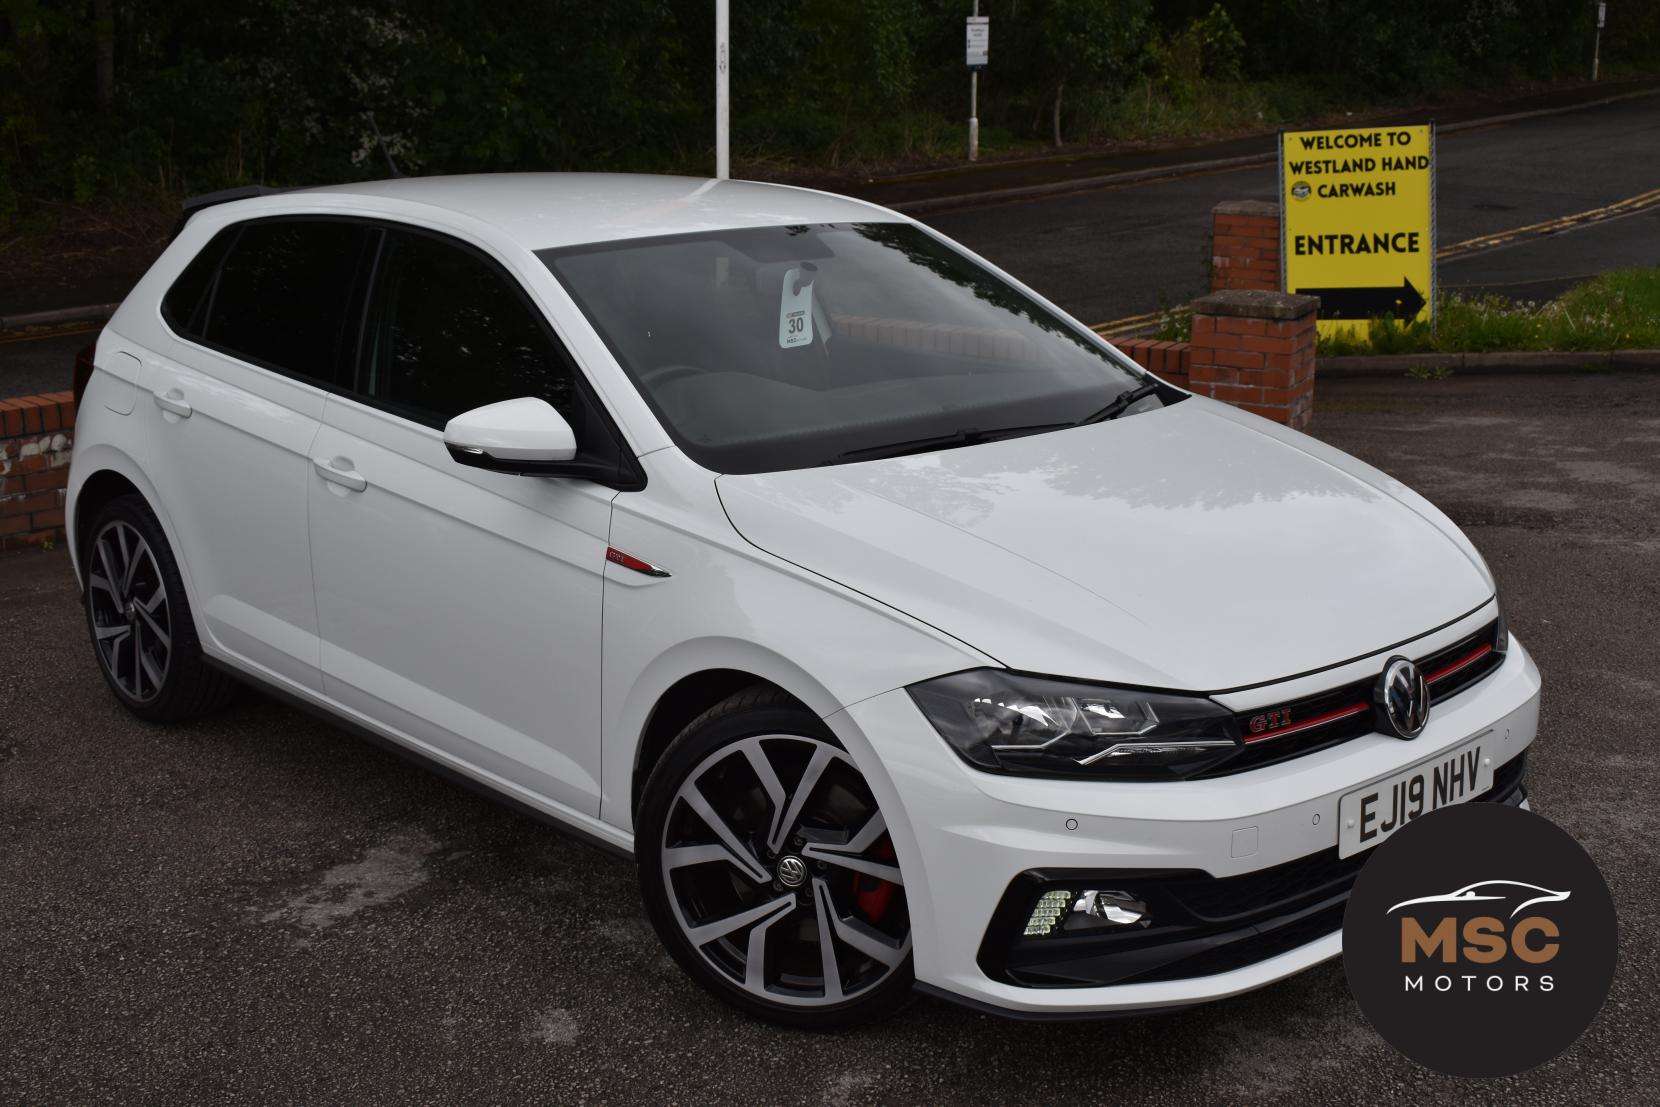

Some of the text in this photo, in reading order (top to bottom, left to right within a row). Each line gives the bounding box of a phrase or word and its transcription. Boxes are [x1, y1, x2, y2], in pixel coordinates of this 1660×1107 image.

[1299, 131, 1411, 150] WELCOME TO
[1289, 156, 1430, 175] WESTLAND HAND
[1317, 182, 1396, 198] CARWASH
[1295, 232, 1419, 256] ENTRANCE
[788, 317, 804, 334] 30
[1250, 708, 1292, 733] GTI
[1360, 746, 1481, 844] EJ19 NHV
